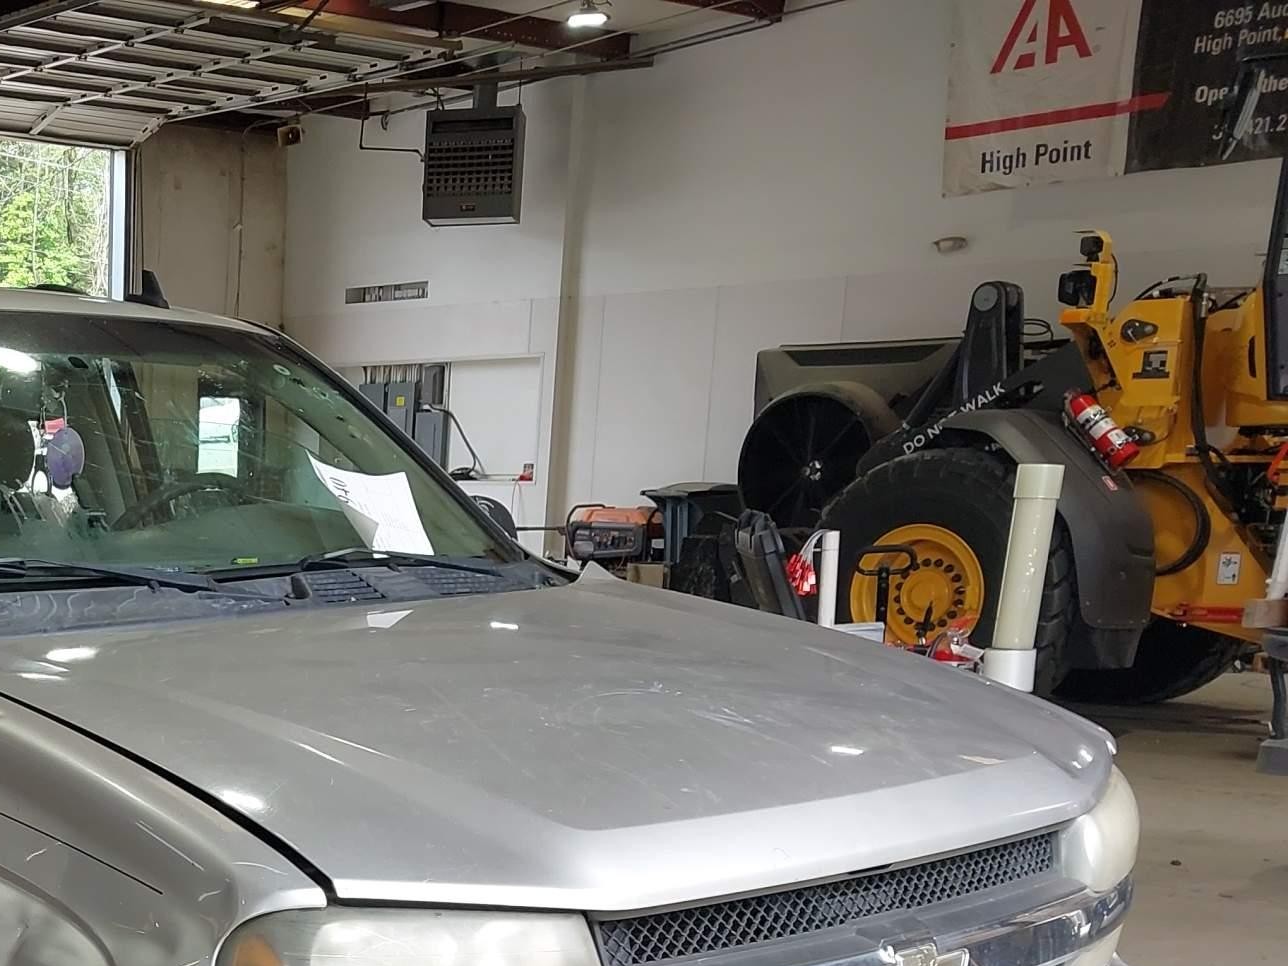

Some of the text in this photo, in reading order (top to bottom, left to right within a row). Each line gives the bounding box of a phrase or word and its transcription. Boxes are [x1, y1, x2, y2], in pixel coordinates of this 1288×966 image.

[1213, 5, 1254, 28] 6695
[1193, 32, 1232, 55] High
[980, 140, 1092, 174] High Point
[902, 382, 1006, 455] DO WALK
